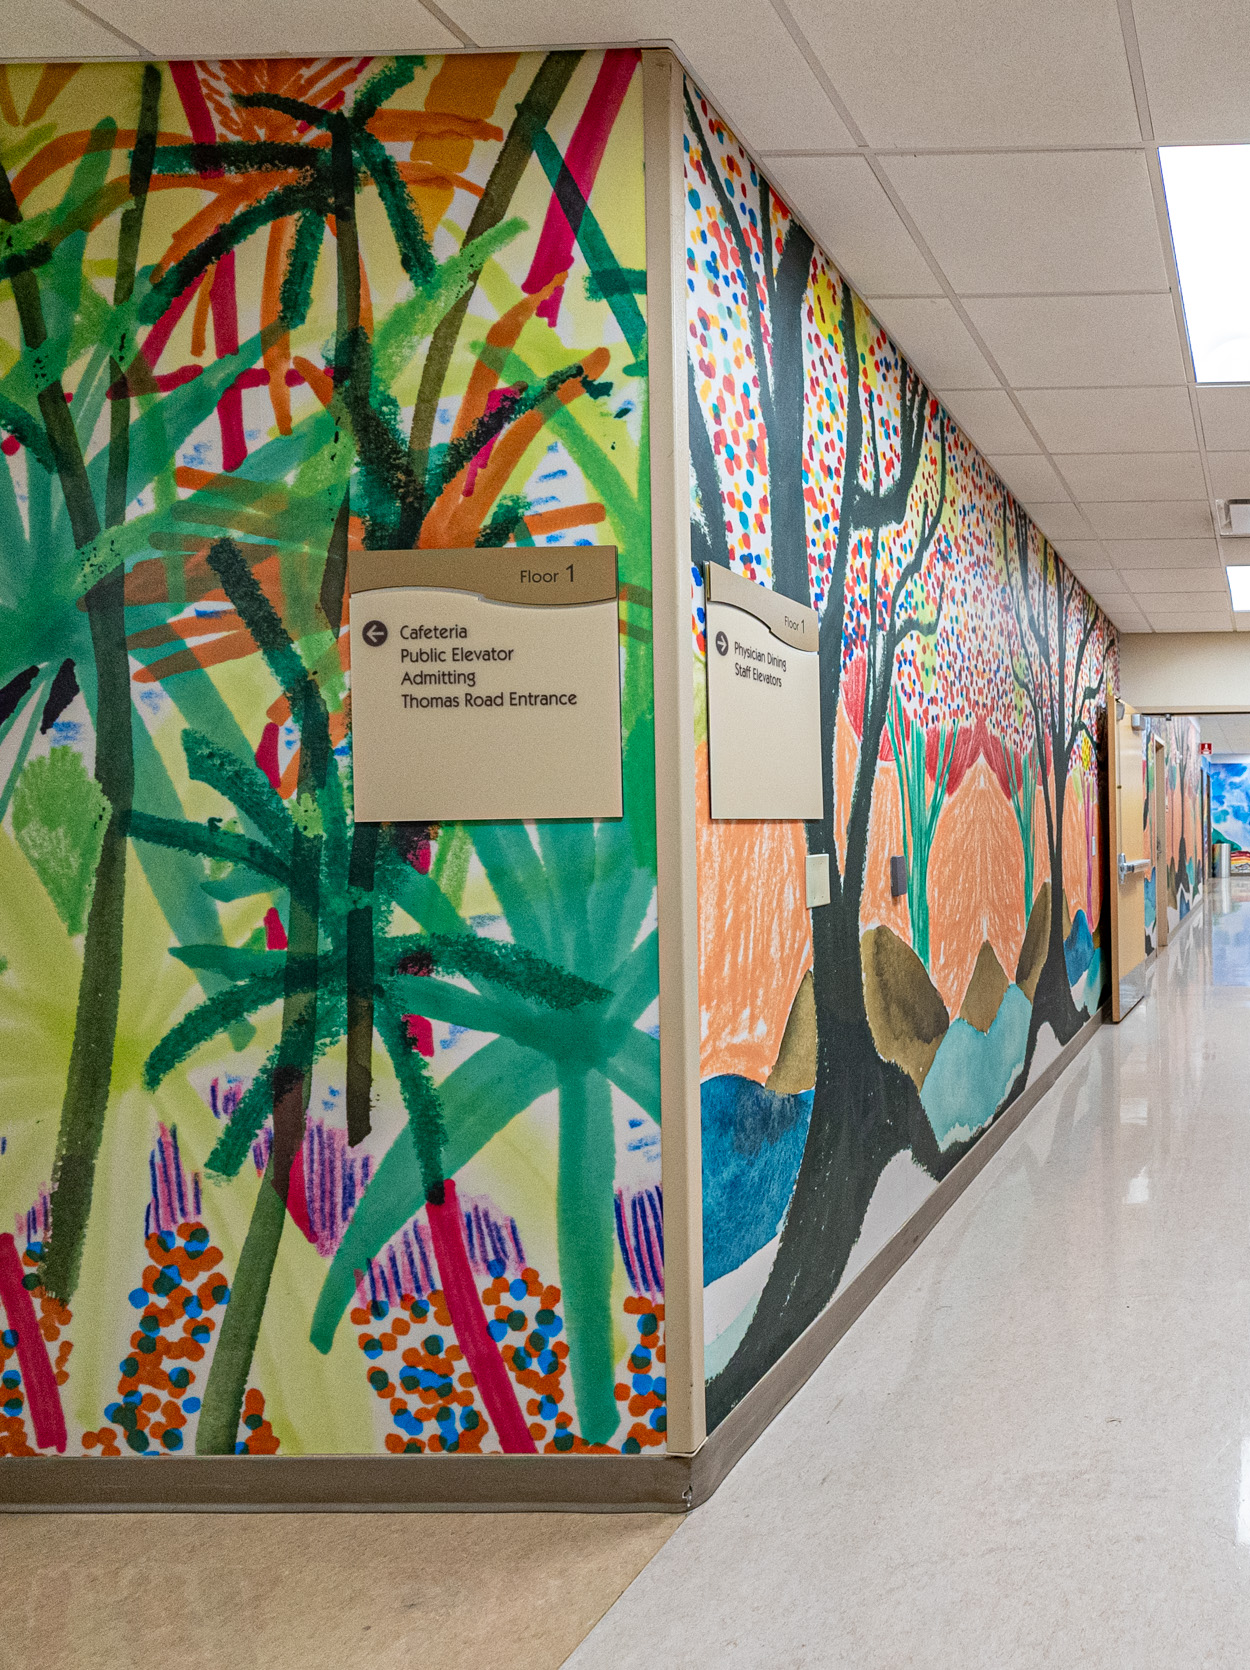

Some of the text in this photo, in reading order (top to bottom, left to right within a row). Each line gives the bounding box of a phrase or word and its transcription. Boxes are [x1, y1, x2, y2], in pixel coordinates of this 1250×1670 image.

[520, 564, 574, 583] Floor 1
[400, 624, 467, 640] Cafeteria
[784, 616, 805, 634] Floor 1
[401, 647, 514, 663] Public Elevator
[734, 641, 787, 672] Physician Dining
[401, 670, 476, 687] Admitting
[735, 663, 782, 687] Staff Elevators
[401, 692, 577, 709] Thomas Road Entrance
